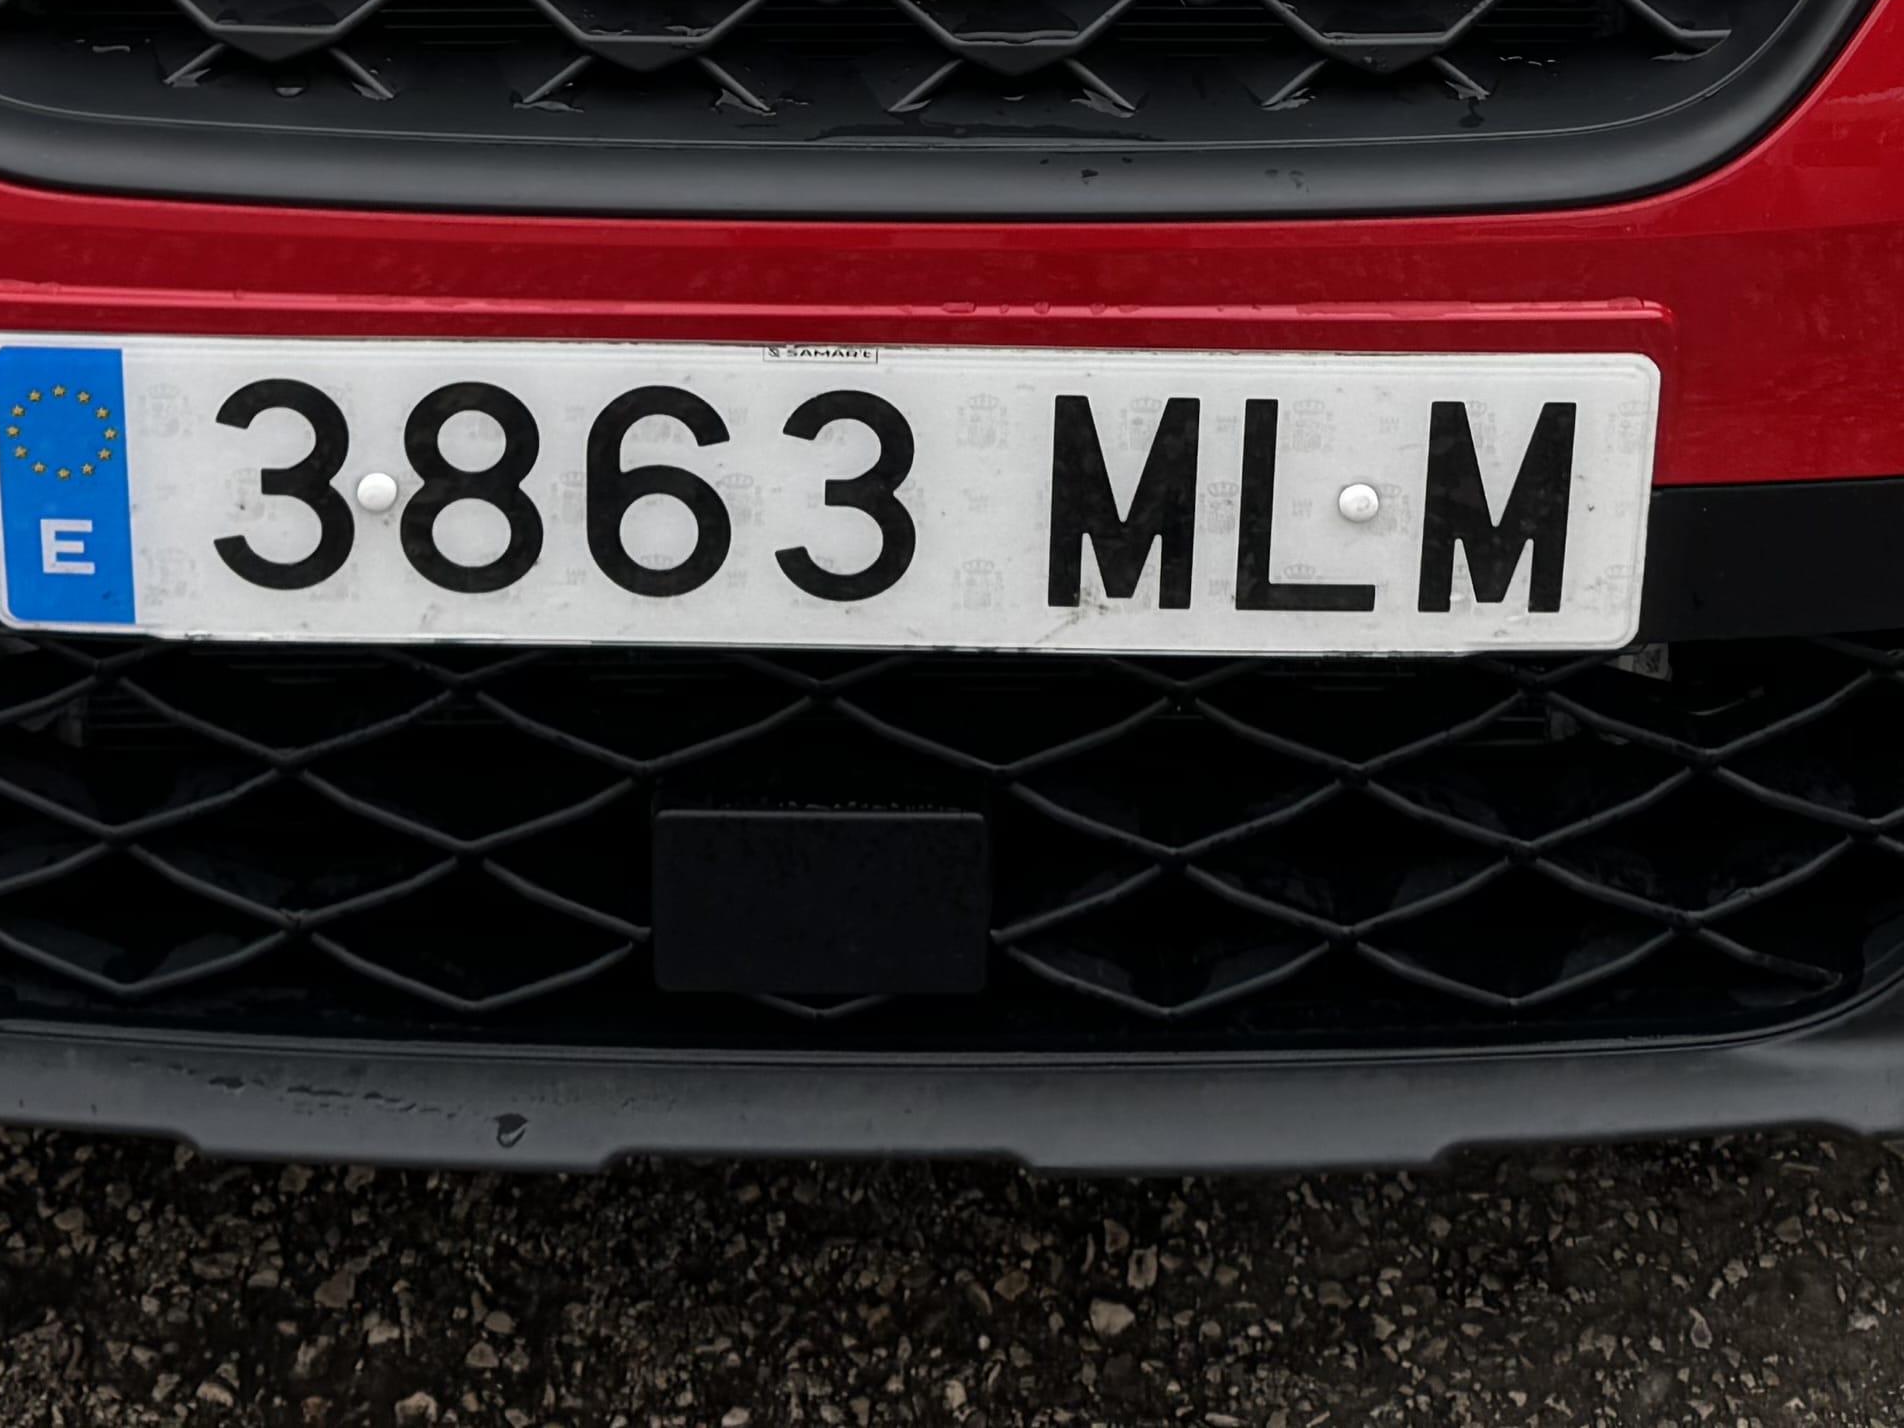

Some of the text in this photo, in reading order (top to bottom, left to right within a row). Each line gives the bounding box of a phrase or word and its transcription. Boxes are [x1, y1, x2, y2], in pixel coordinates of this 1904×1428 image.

[40, 378, 1576, 614] E 3863 MLM
